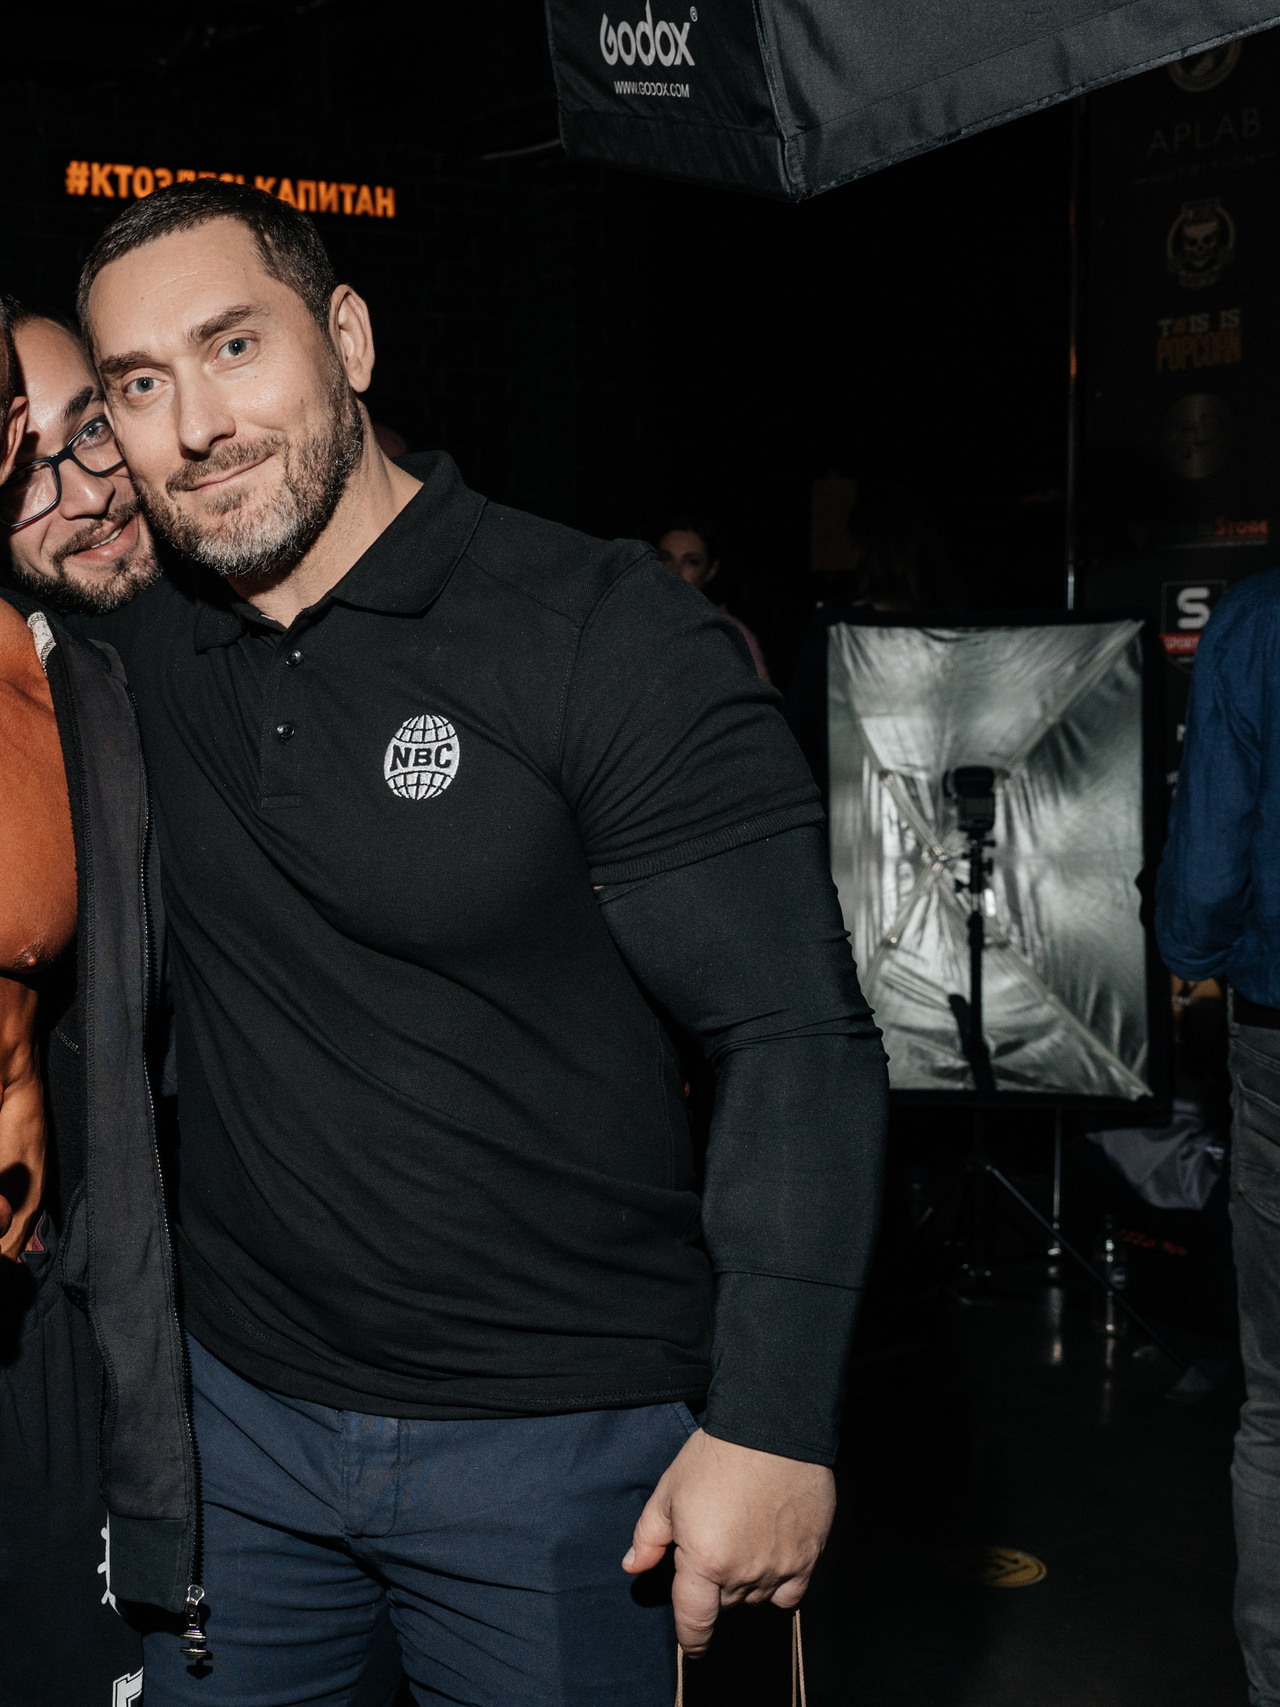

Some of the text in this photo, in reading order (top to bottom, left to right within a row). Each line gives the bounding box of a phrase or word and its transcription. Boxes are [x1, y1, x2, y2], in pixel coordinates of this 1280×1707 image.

[613, 80, 691, 98] WWW.GODOX.COM
[1146, 105, 1262, 159] APLAB
[389, 742, 453, 772] NBC
